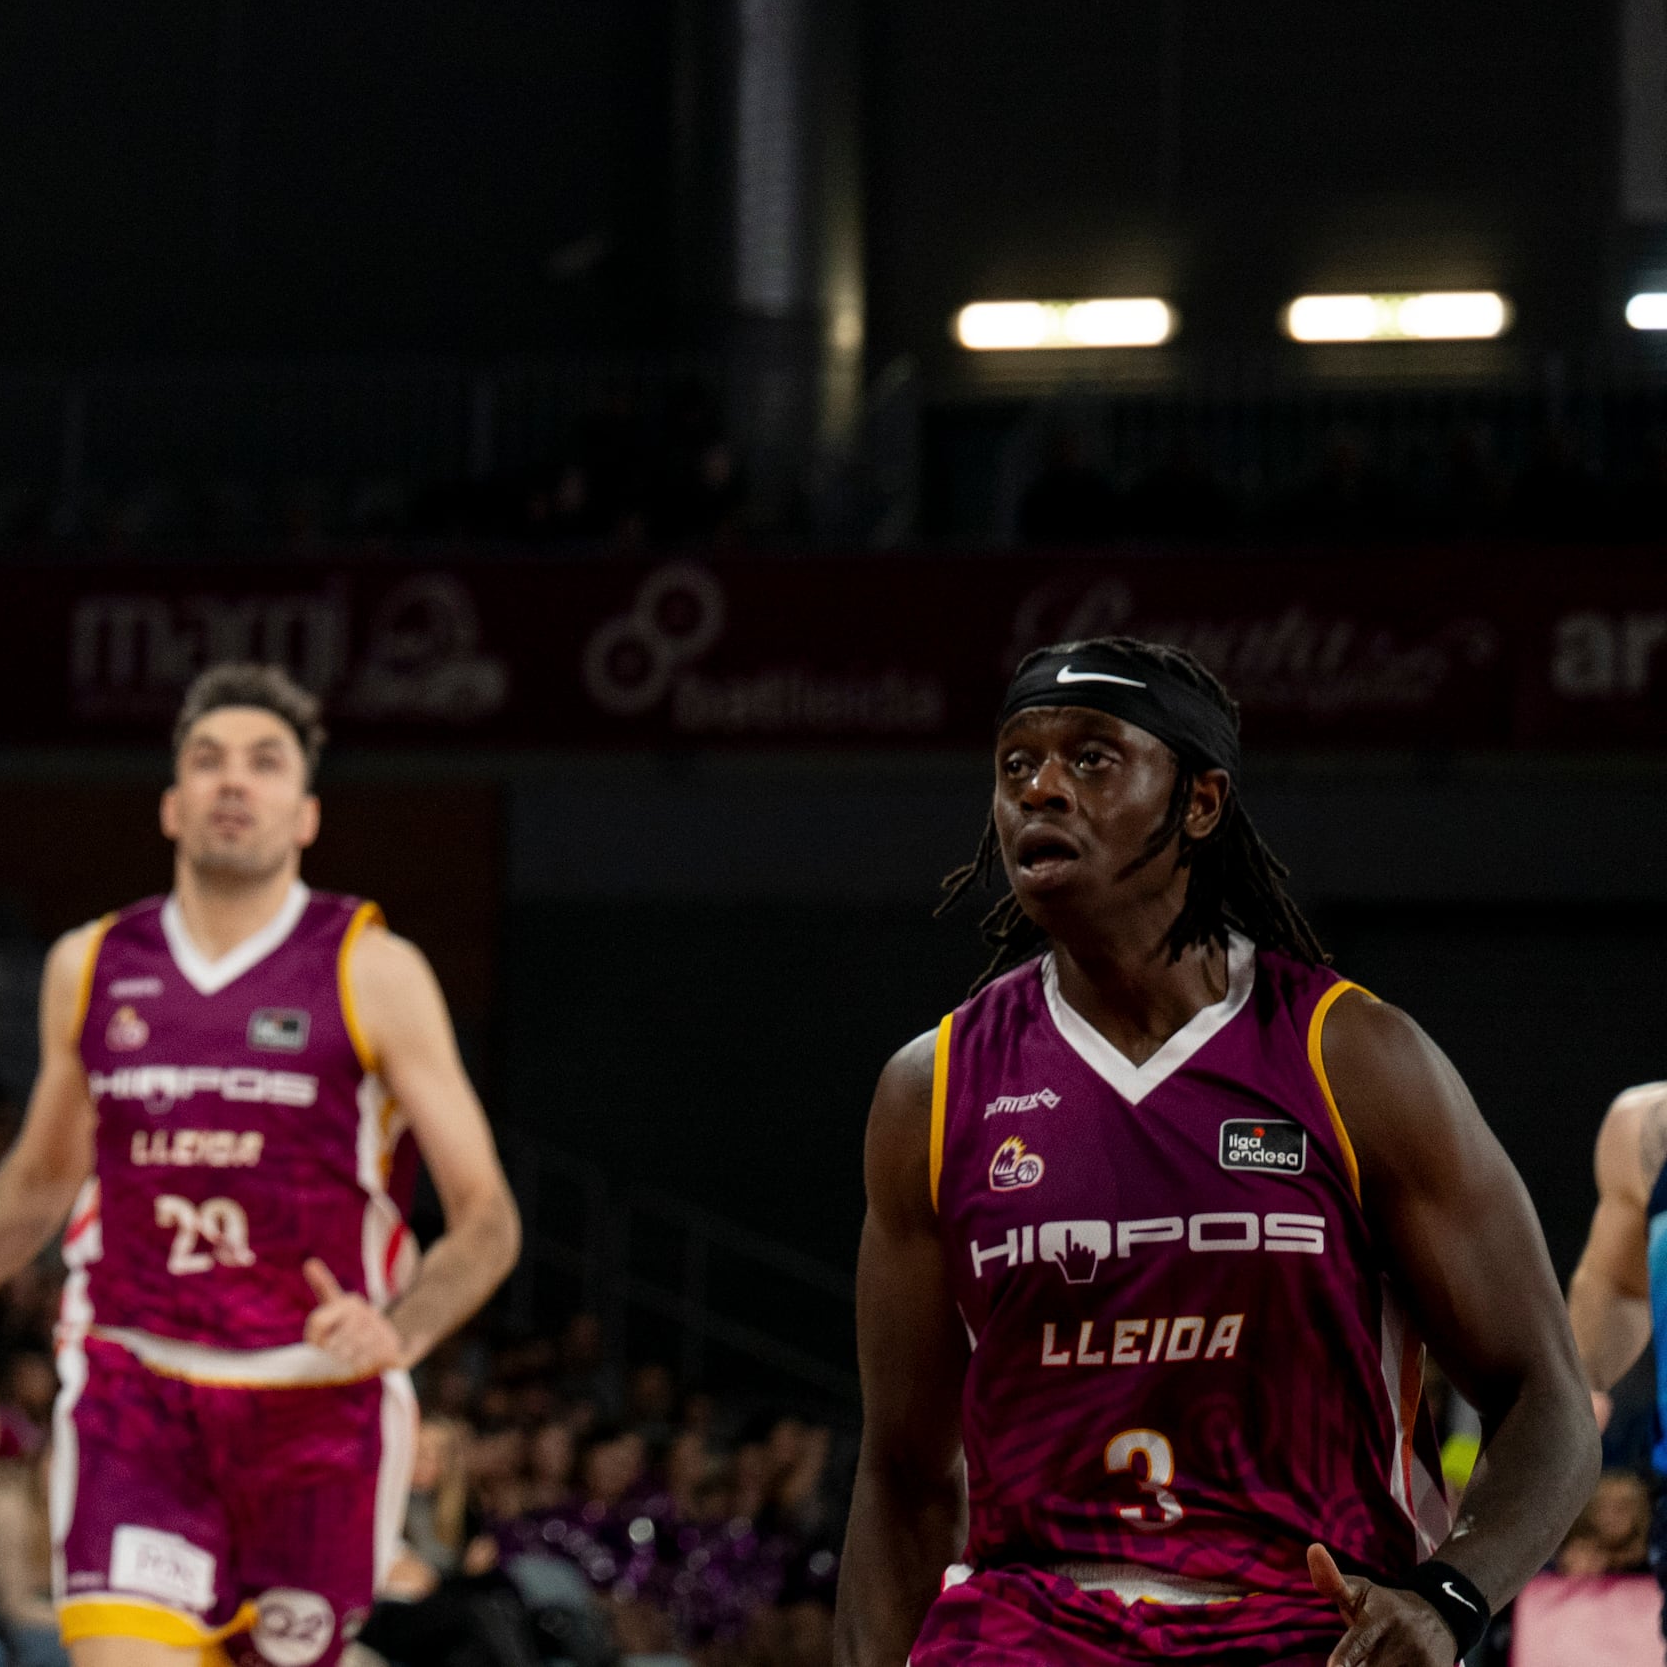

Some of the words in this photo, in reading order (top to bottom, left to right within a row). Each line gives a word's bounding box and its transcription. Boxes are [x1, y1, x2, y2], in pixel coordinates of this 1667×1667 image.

[129, 1128, 266, 1168] LLEIDA
[1228, 1133, 1262, 1151] liga
[1228, 1148, 1300, 1167] endesa
[153, 1193, 258, 1277] 29
[969, 1211, 1327, 1284] HIOPOS
[1040, 1312, 1246, 1367] LLEIDA
[1103, 1427, 1184, 1531] 3
